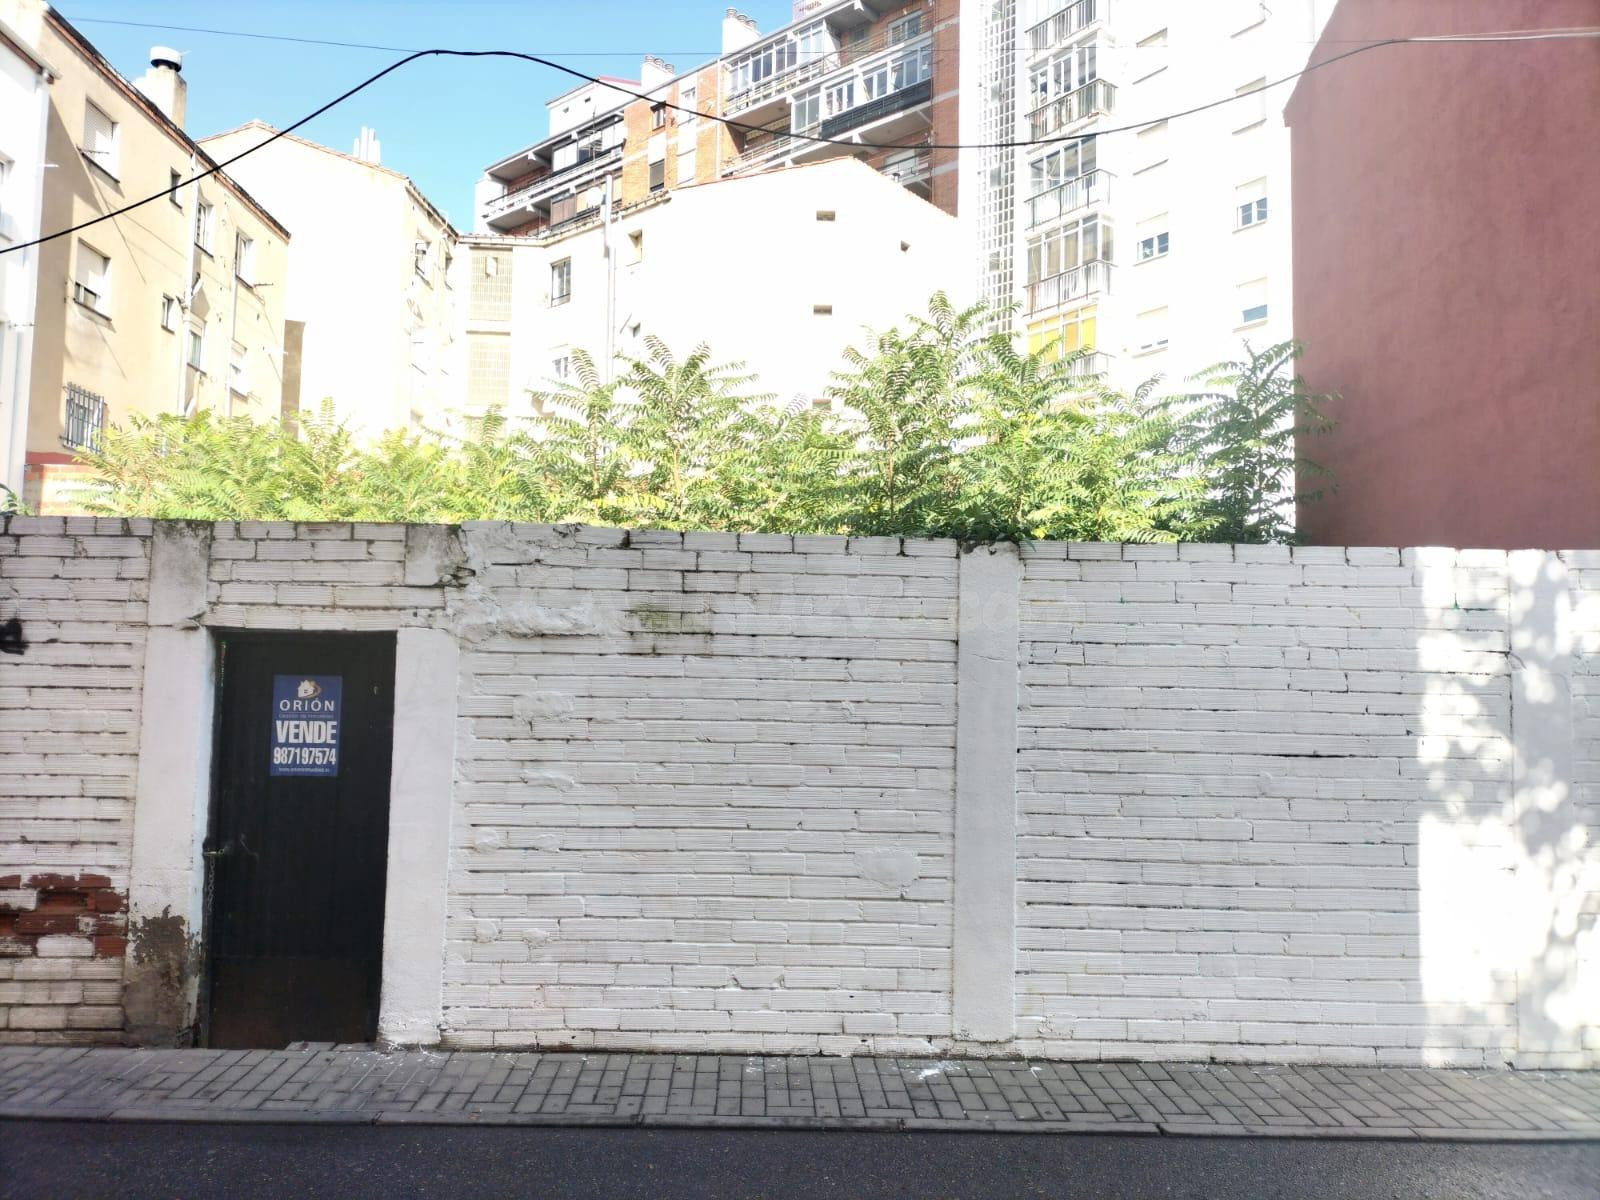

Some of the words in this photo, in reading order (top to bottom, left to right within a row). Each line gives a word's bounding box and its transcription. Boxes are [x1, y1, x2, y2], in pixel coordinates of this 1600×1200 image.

[280, 698, 335, 711] ORIÓN
[276, 720, 337, 744] VENDE
[273, 747, 336, 765] 987197574
